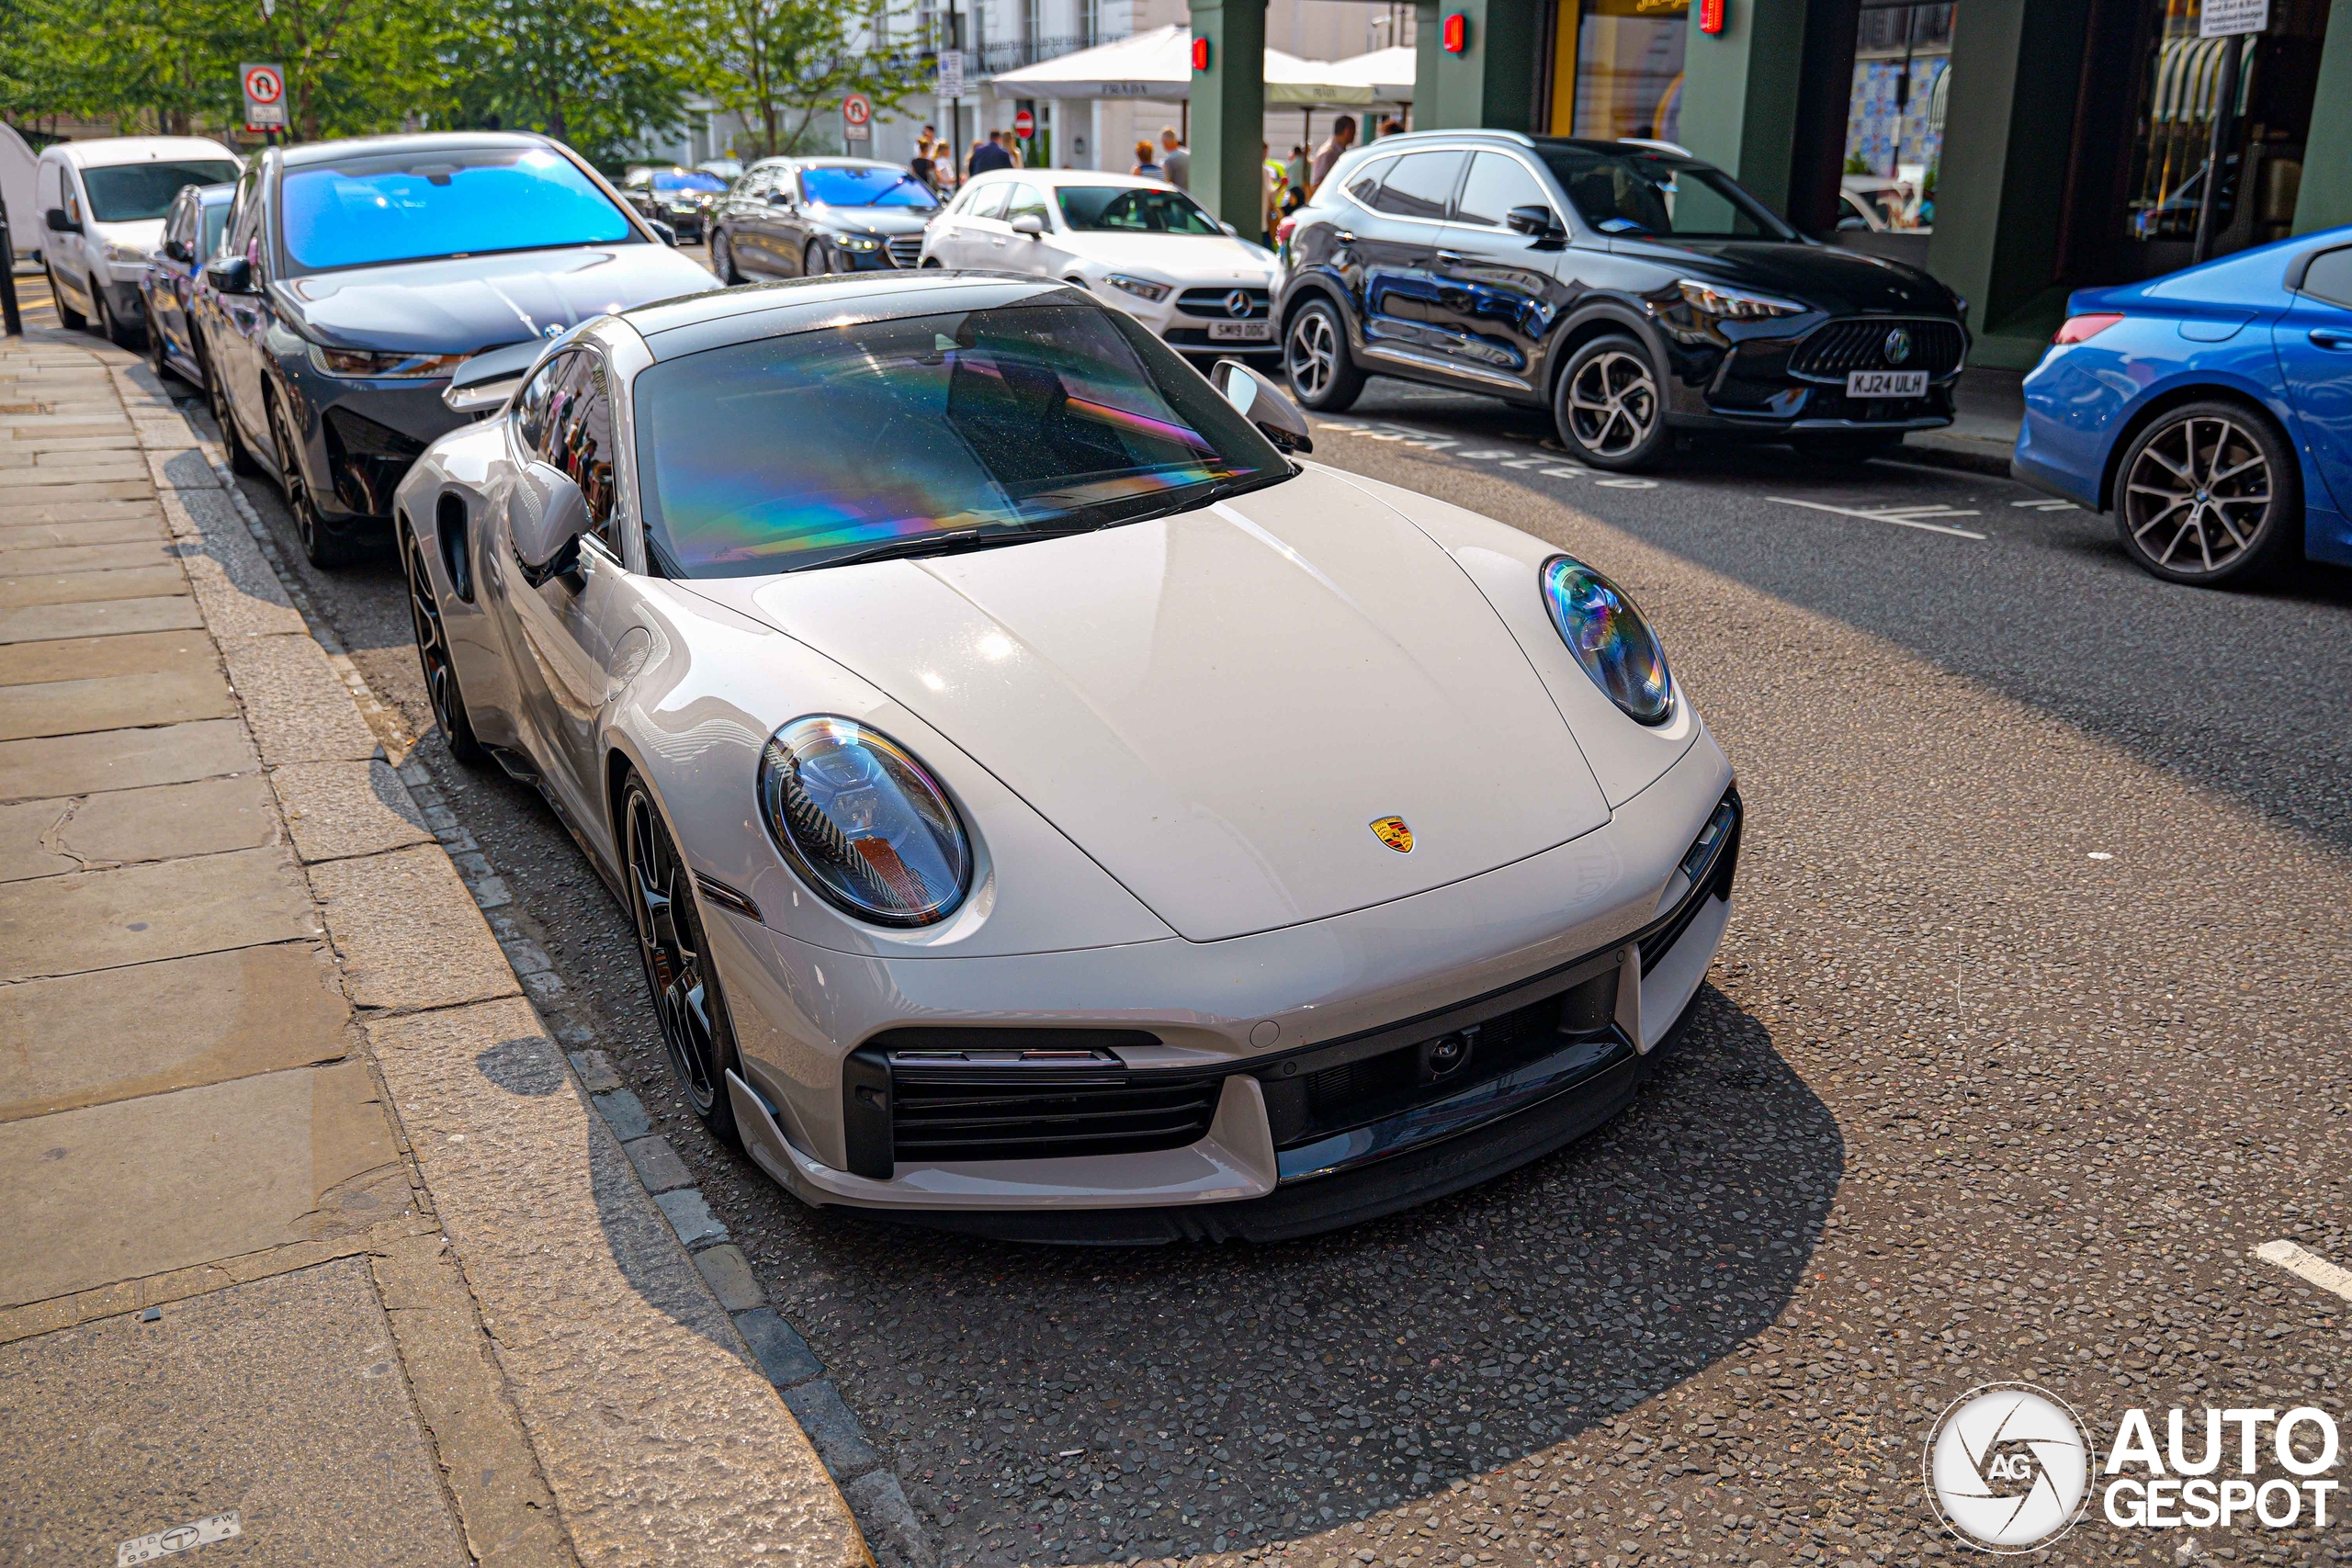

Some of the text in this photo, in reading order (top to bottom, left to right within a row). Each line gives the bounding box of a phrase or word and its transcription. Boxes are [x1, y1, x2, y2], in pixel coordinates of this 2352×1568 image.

[1853, 374, 1922, 393] KJ24 ULH
[211, 1513, 234, 1527] FW
